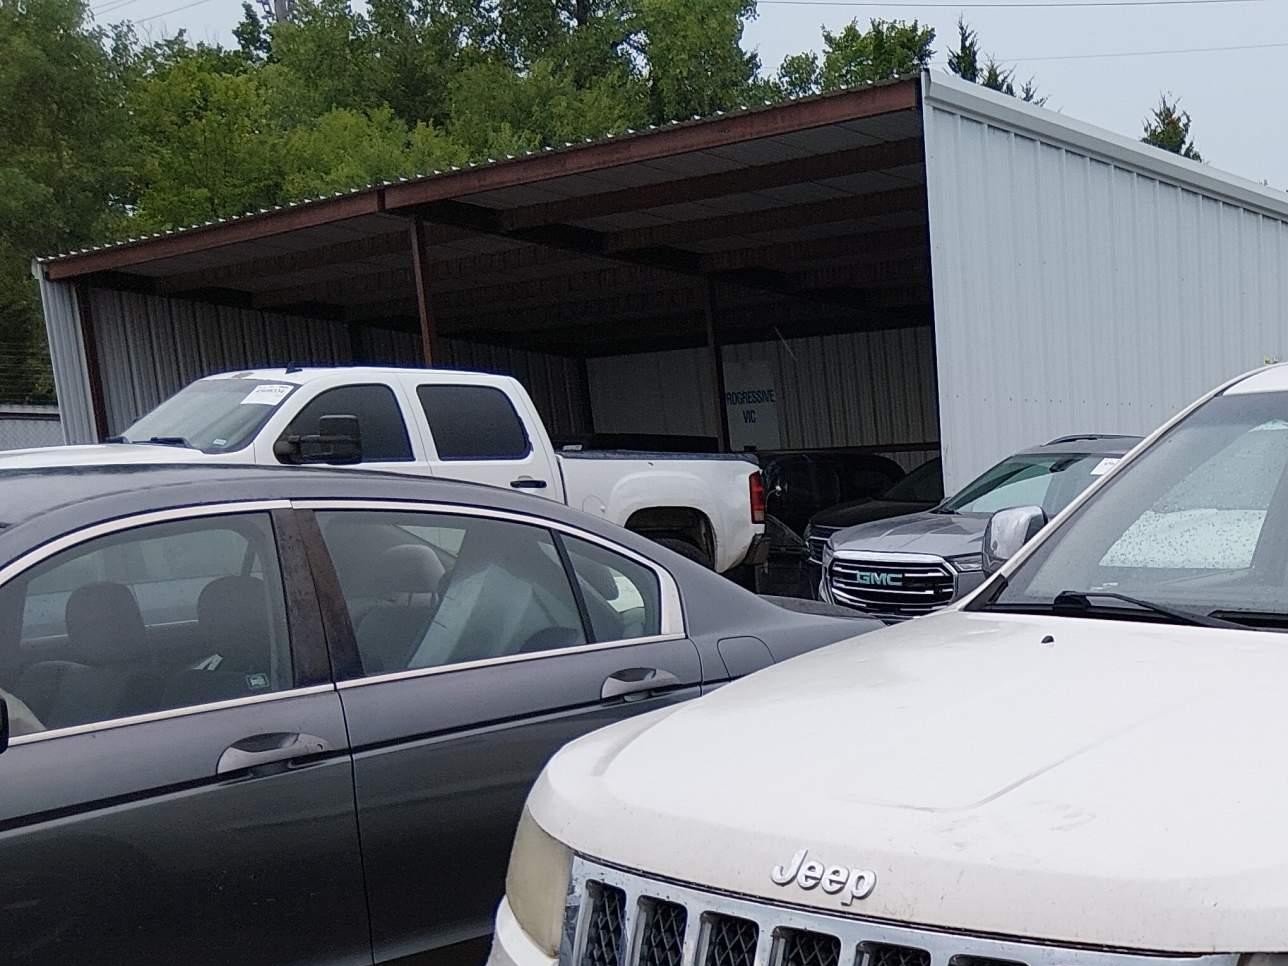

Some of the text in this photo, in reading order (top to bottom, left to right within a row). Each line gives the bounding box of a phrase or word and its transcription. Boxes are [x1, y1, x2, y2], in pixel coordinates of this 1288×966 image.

[725, 389, 775, 405] ROGRESSIVE
[856, 571, 903, 586] GMC
[770, 848, 877, 907] Jeep
